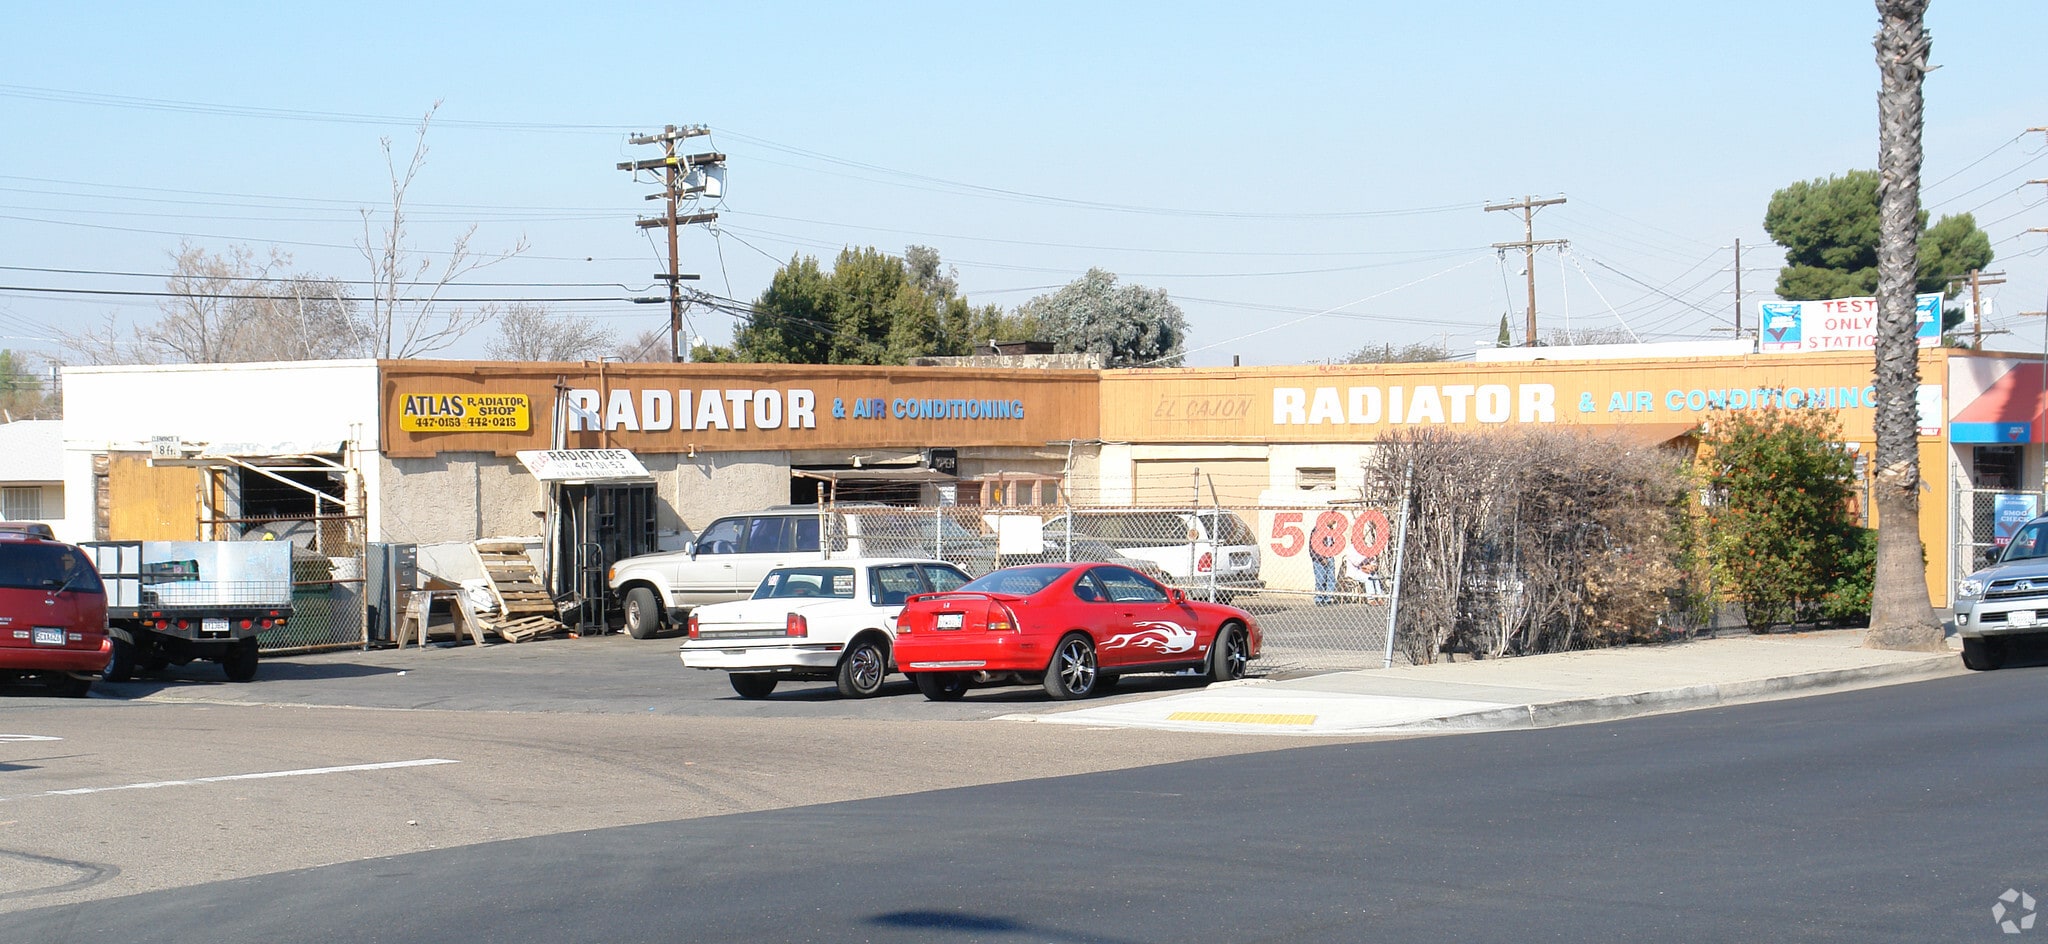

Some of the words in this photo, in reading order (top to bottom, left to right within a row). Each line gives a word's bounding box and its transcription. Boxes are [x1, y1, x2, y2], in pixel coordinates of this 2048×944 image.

[1822, 300, 1878, 314] TEST
[1825, 317, 1873, 331] ONLY
[1808, 334, 1877, 349] STATIO
[404, 395, 465, 417] ATLAS
[467, 397, 526, 407] RADIATOR
[568, 389, 816, 431] RADIATOR
[832, 397, 846, 418] &
[853, 397, 886, 419] AIR
[892, 397, 1025, 419] CONDITIONING
[1273, 383, 1556, 424] RADIATOR
[1578, 392, 1596, 412] &
[1608, 391, 1654, 412] AIR
[479, 407, 516, 416] SHOP
[548, 450, 627, 461] RADIATORS
[1270, 510, 1390, 558] 580
